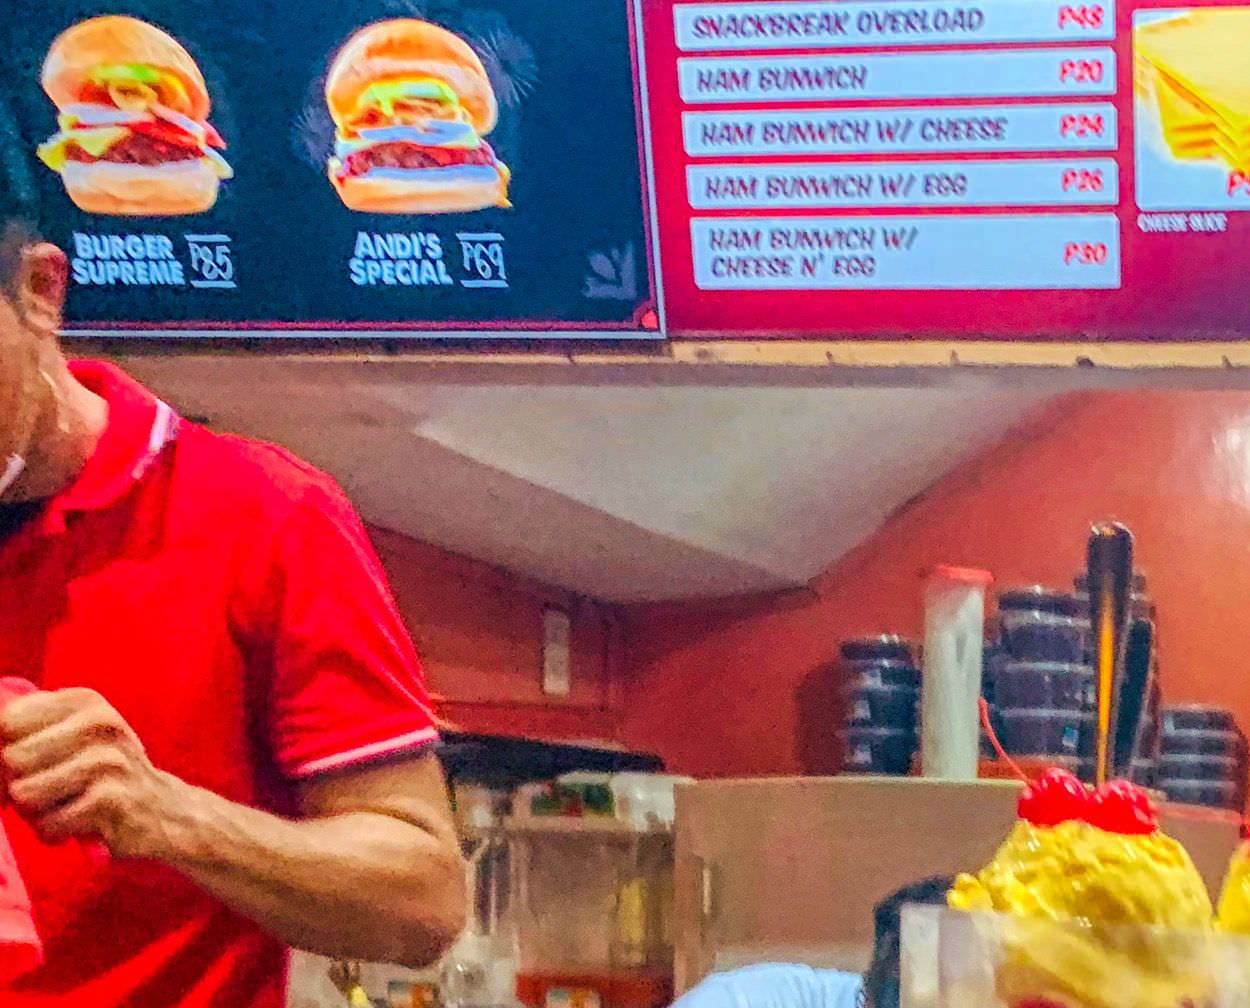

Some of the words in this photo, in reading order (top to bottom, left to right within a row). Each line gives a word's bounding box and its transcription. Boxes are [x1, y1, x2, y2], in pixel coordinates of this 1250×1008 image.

[692, 11, 847, 39] SNACKBREAK
[857, 8, 985, 35] OVERLOAD
[697, 69, 750, 93] HAM
[758, 65, 868, 92] BUNWICH
[1059, 60, 1104, 83] P20
[701, 122, 753, 146] HAM
[762, 120, 869, 144] BUNWICH
[876, 118, 911, 143] W/
[921, 117, 1008, 142] CHEESE
[1060, 114, 1104, 137] P24
[705, 175, 757, 199] HAM
[766, 173, 874, 198] BUNWICH
[880, 173, 915, 197] W/
[922, 173, 967, 197] EGG
[1061, 168, 1104, 192] P26
[73, 231, 175, 260] BURGER
[354, 231, 443, 259] ANDI'S
[710, 228, 761, 252] HAM
[769, 227, 877, 251] BUNWICH
[883, 226, 919, 251] W/
[1063, 241, 1108, 265] P30
[71, 258, 185, 286] SUPREME
[349, 257, 453, 286] SPECIAL
[711, 255, 794, 279] CHEESE
[832, 255, 876, 278] EGG
